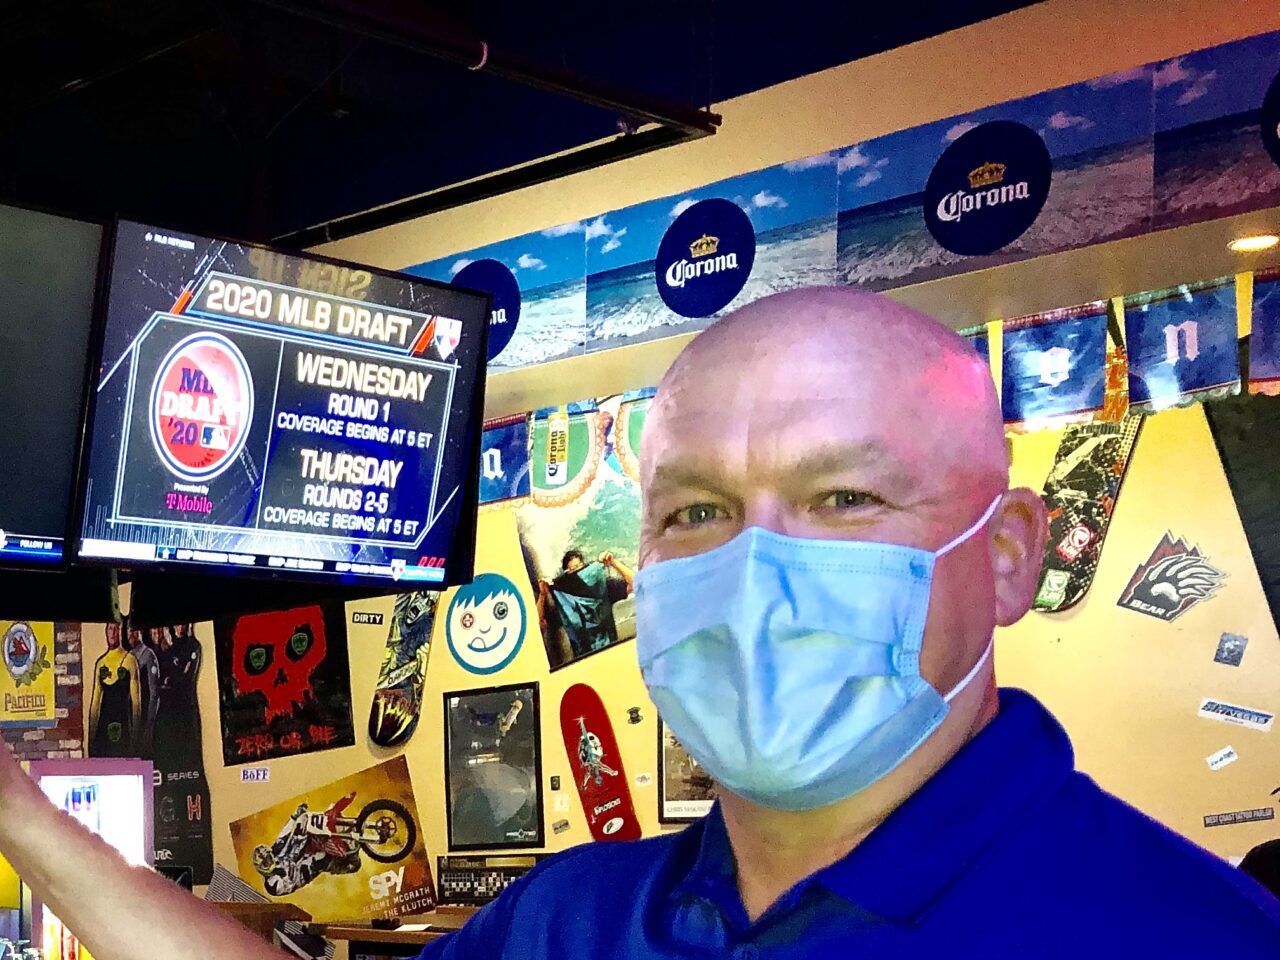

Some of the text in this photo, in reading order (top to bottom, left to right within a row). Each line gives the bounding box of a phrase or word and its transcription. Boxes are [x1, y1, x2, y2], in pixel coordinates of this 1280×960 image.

[937, 181, 1031, 222] Corona
[665, 252, 738, 288] Corona
[206, 280, 414, 345] 2020 MLB DRAFT
[297, 351, 433, 402] WEDNESDAY
[327, 393, 391, 423] ROUND 1
[277, 412, 434, 449] COVERAGE BEGINS AT 5 ET
[300, 448, 404, 489] THURSDAY
[548, 429, 559, 478] Corona
[303, 484, 390, 514] ROUNDS 2-5
[263, 506, 420, 536] COVERAGE BEGINS AT 5 ET
[353, 613, 382, 624] DIRTY
[235, 732, 274, 758] ZERO
[280, 731, 302, 750] OR
[167, 770, 200, 781] SERIES
[368, 865, 406, 900] SPY
[393, 886, 431, 904] MCGRATH
[384, 896, 433, 918] THE KLUTCH
